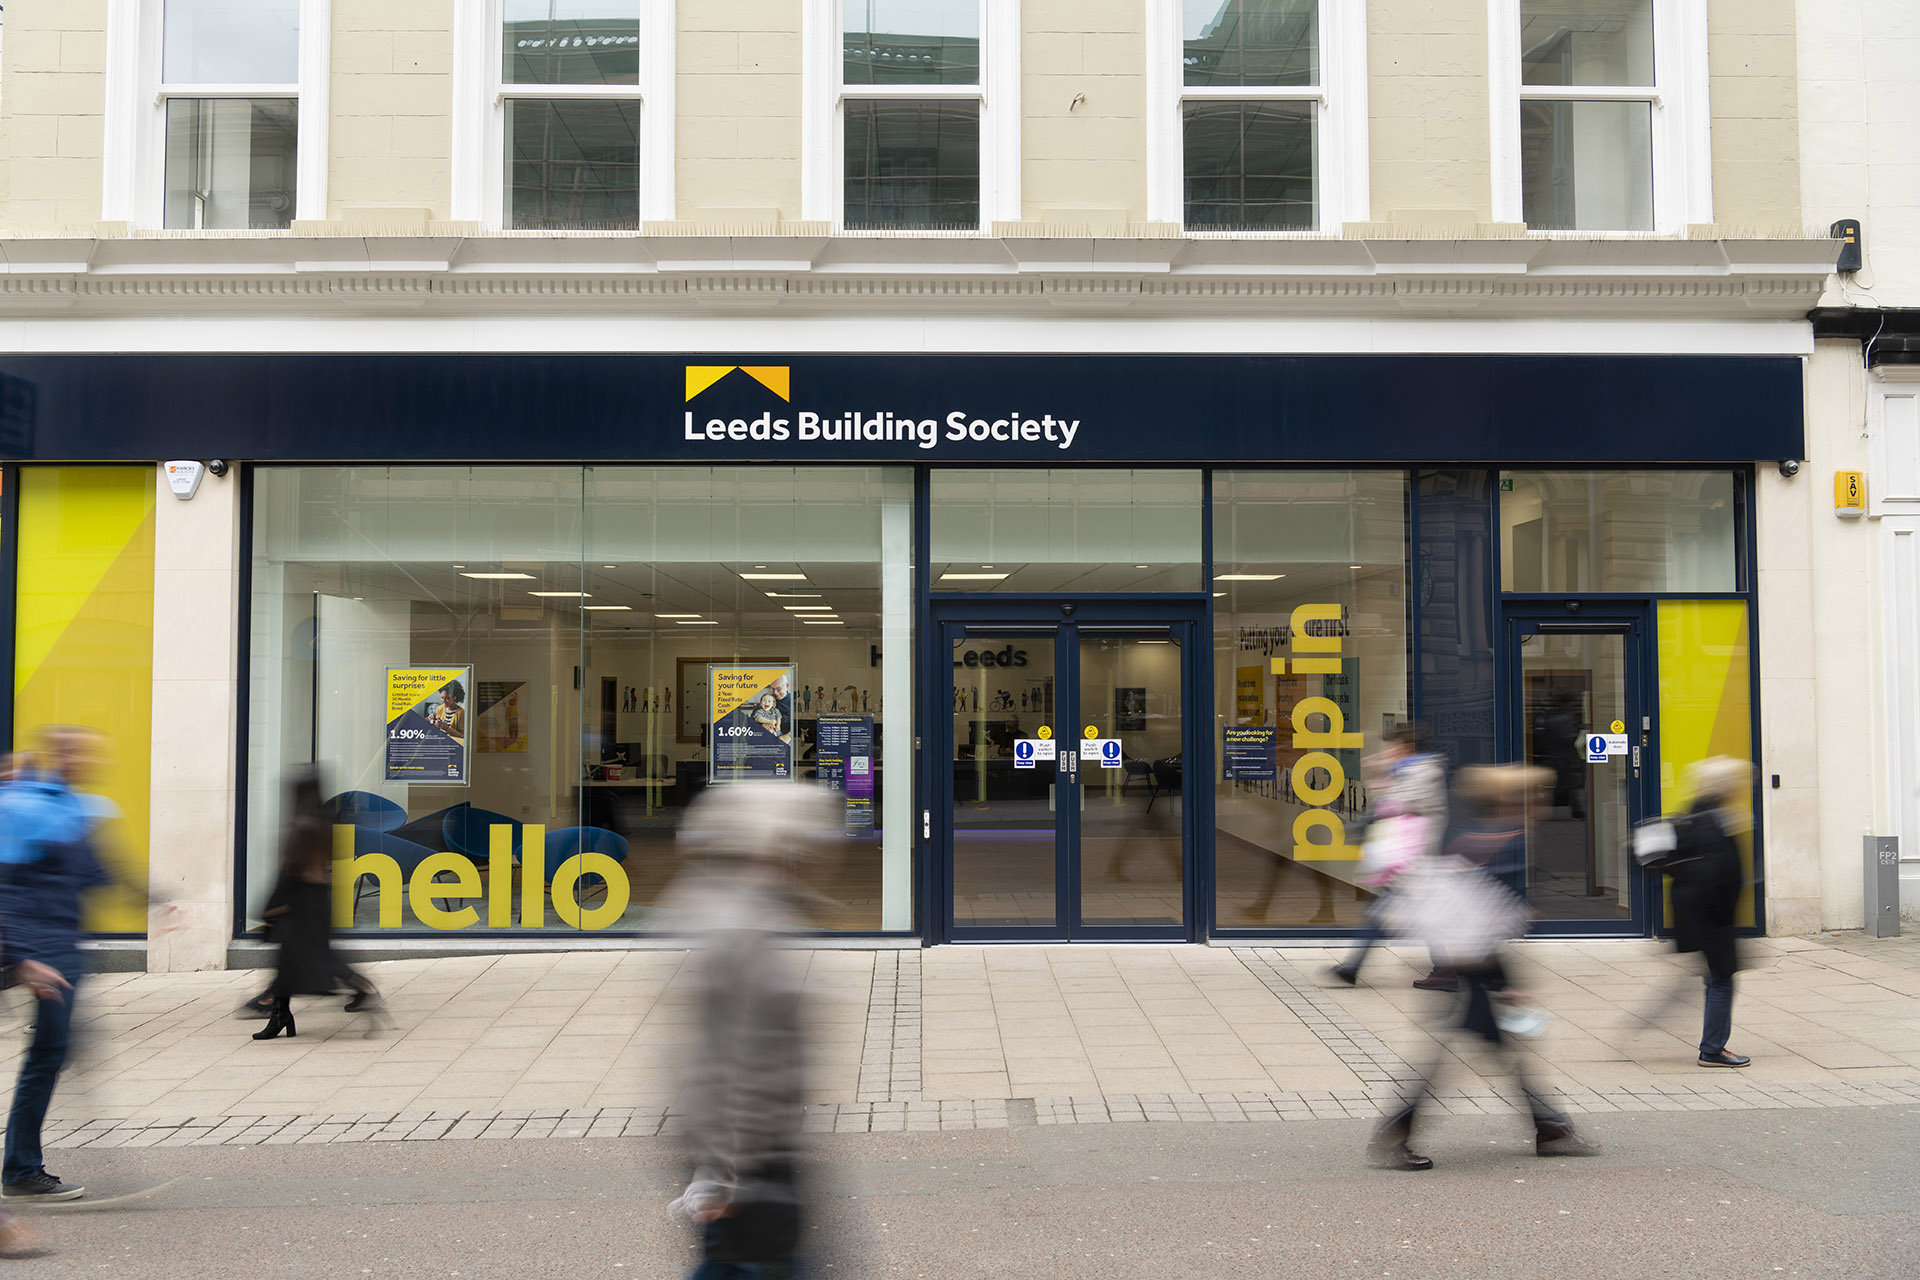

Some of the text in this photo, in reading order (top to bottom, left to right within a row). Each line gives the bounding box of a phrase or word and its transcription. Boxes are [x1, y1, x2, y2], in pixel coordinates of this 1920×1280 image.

[684, 411, 1080, 449] Leeds Building Society
[1849, 475, 1857, 497] SAV
[1240, 623, 1268, 656] Putting
[953, 644, 1028, 667] eeds
[392, 674, 417, 682] Saving
[718, 673, 754, 682] Saving for
[392, 682, 426, 690] surprises
[718, 682, 735, 690] your
[390, 729, 425, 739] 1.90%
[718, 726, 754, 737] 1.60%
[1270, 603, 1364, 861] pop in
[1879, 851, 1897, 860] FP2
[331, 823, 630, 931] hello
